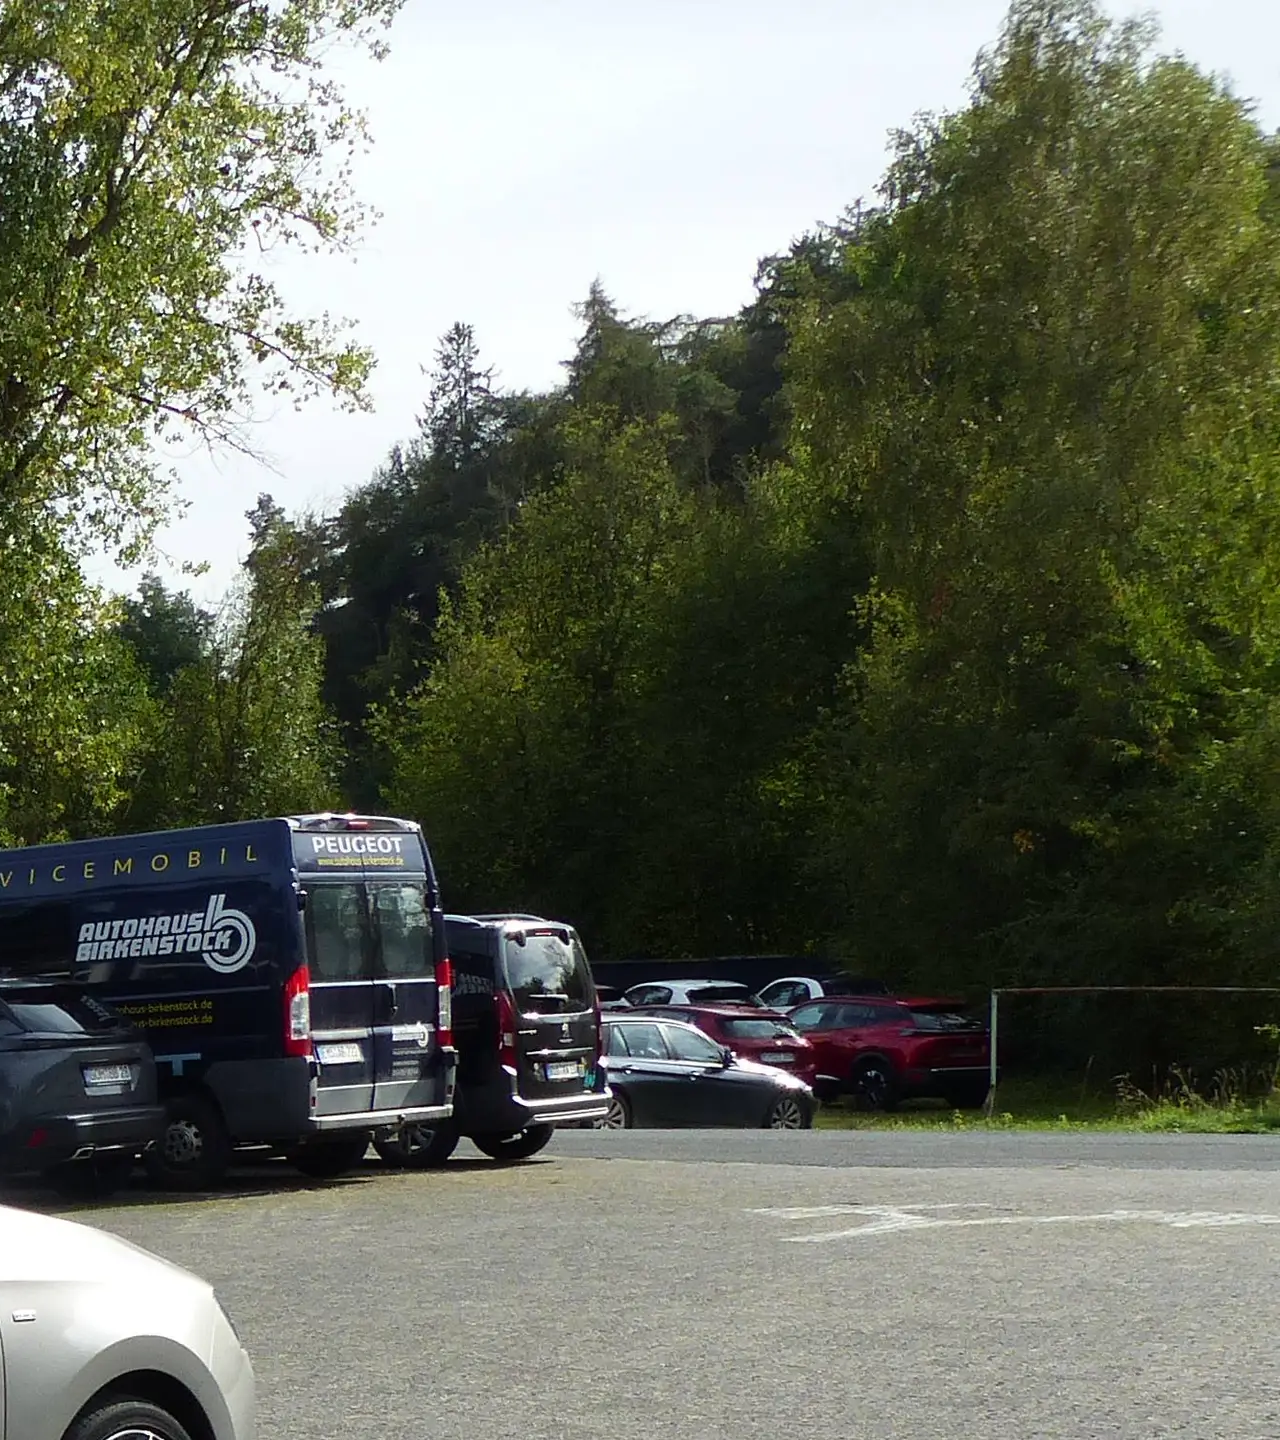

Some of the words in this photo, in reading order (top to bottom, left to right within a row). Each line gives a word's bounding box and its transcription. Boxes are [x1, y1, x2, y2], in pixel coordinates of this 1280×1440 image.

[312, 836, 402, 853] PEUGEOT
[78, 912, 204, 942] AUTOHAUS
[75, 930, 234, 962] BIRKENSTOCK
